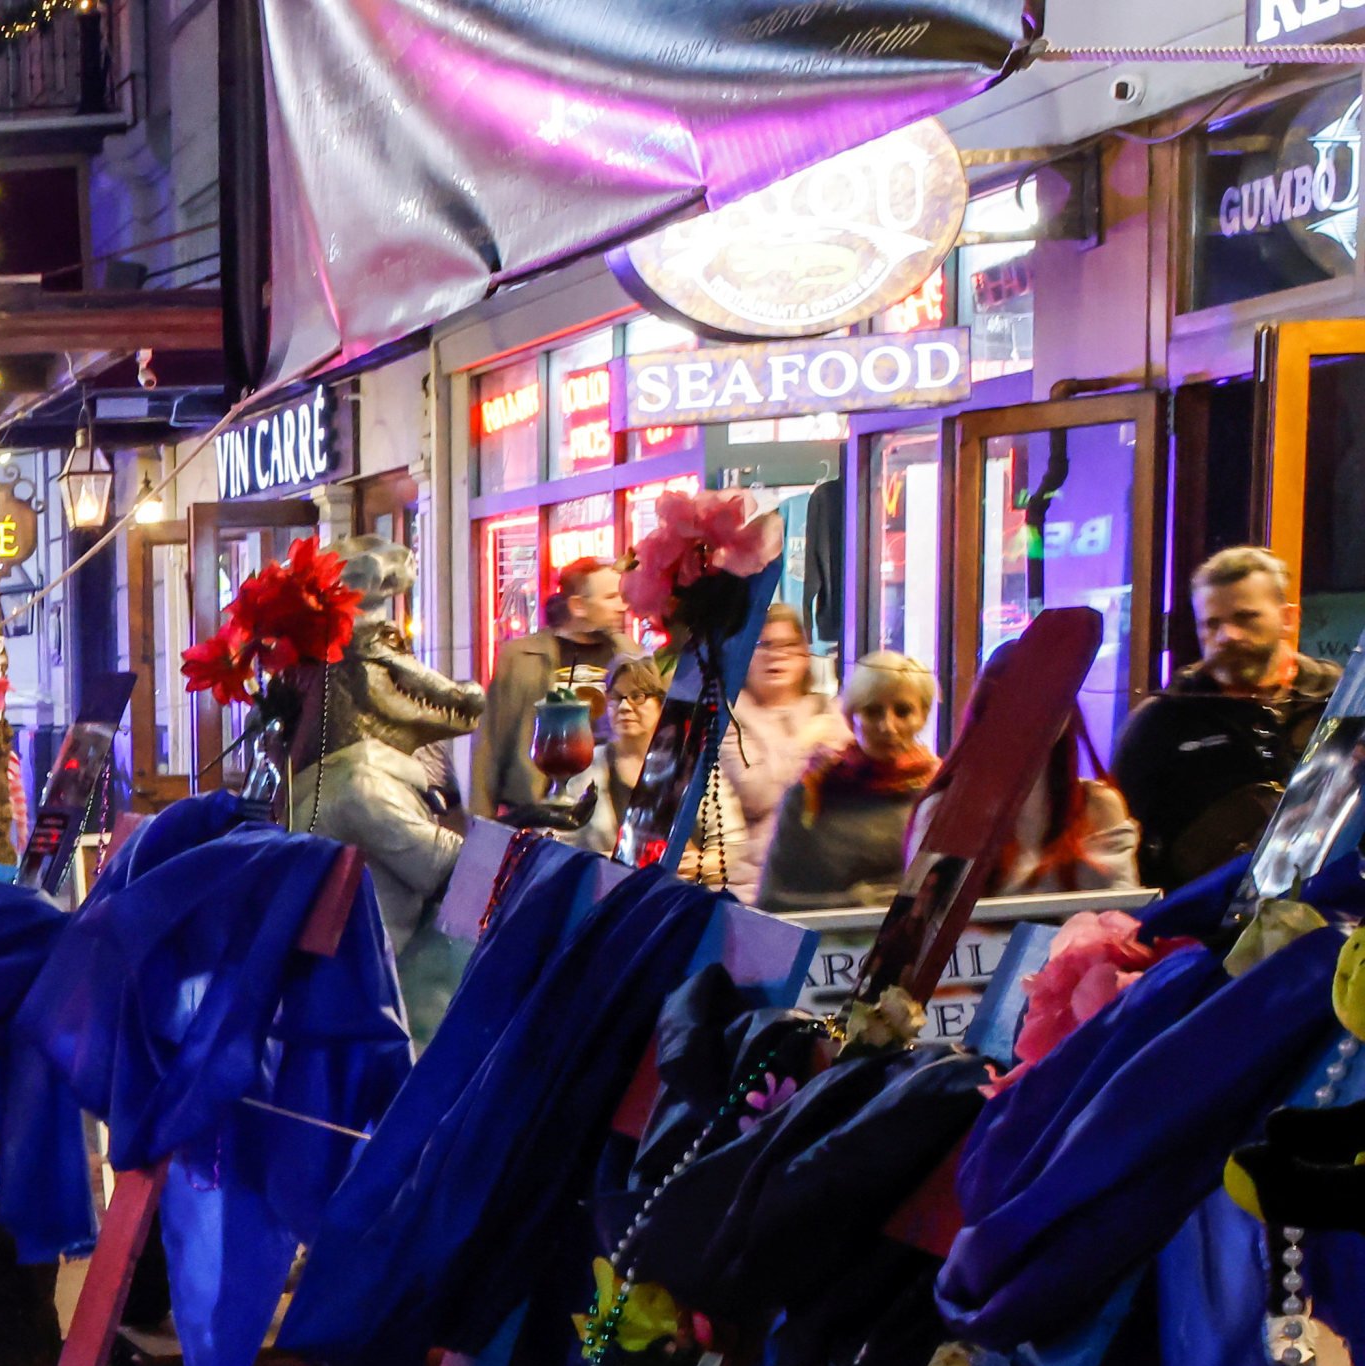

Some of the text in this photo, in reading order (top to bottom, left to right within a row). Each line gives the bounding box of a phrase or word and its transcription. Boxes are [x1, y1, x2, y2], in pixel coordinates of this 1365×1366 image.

[847, 17, 931, 57] Victim
[1219, 161, 1337, 237] GUMBO
[636, 342, 960, 413] SEAFOOD
[214, 384, 327, 500] VIN CARRÉ
